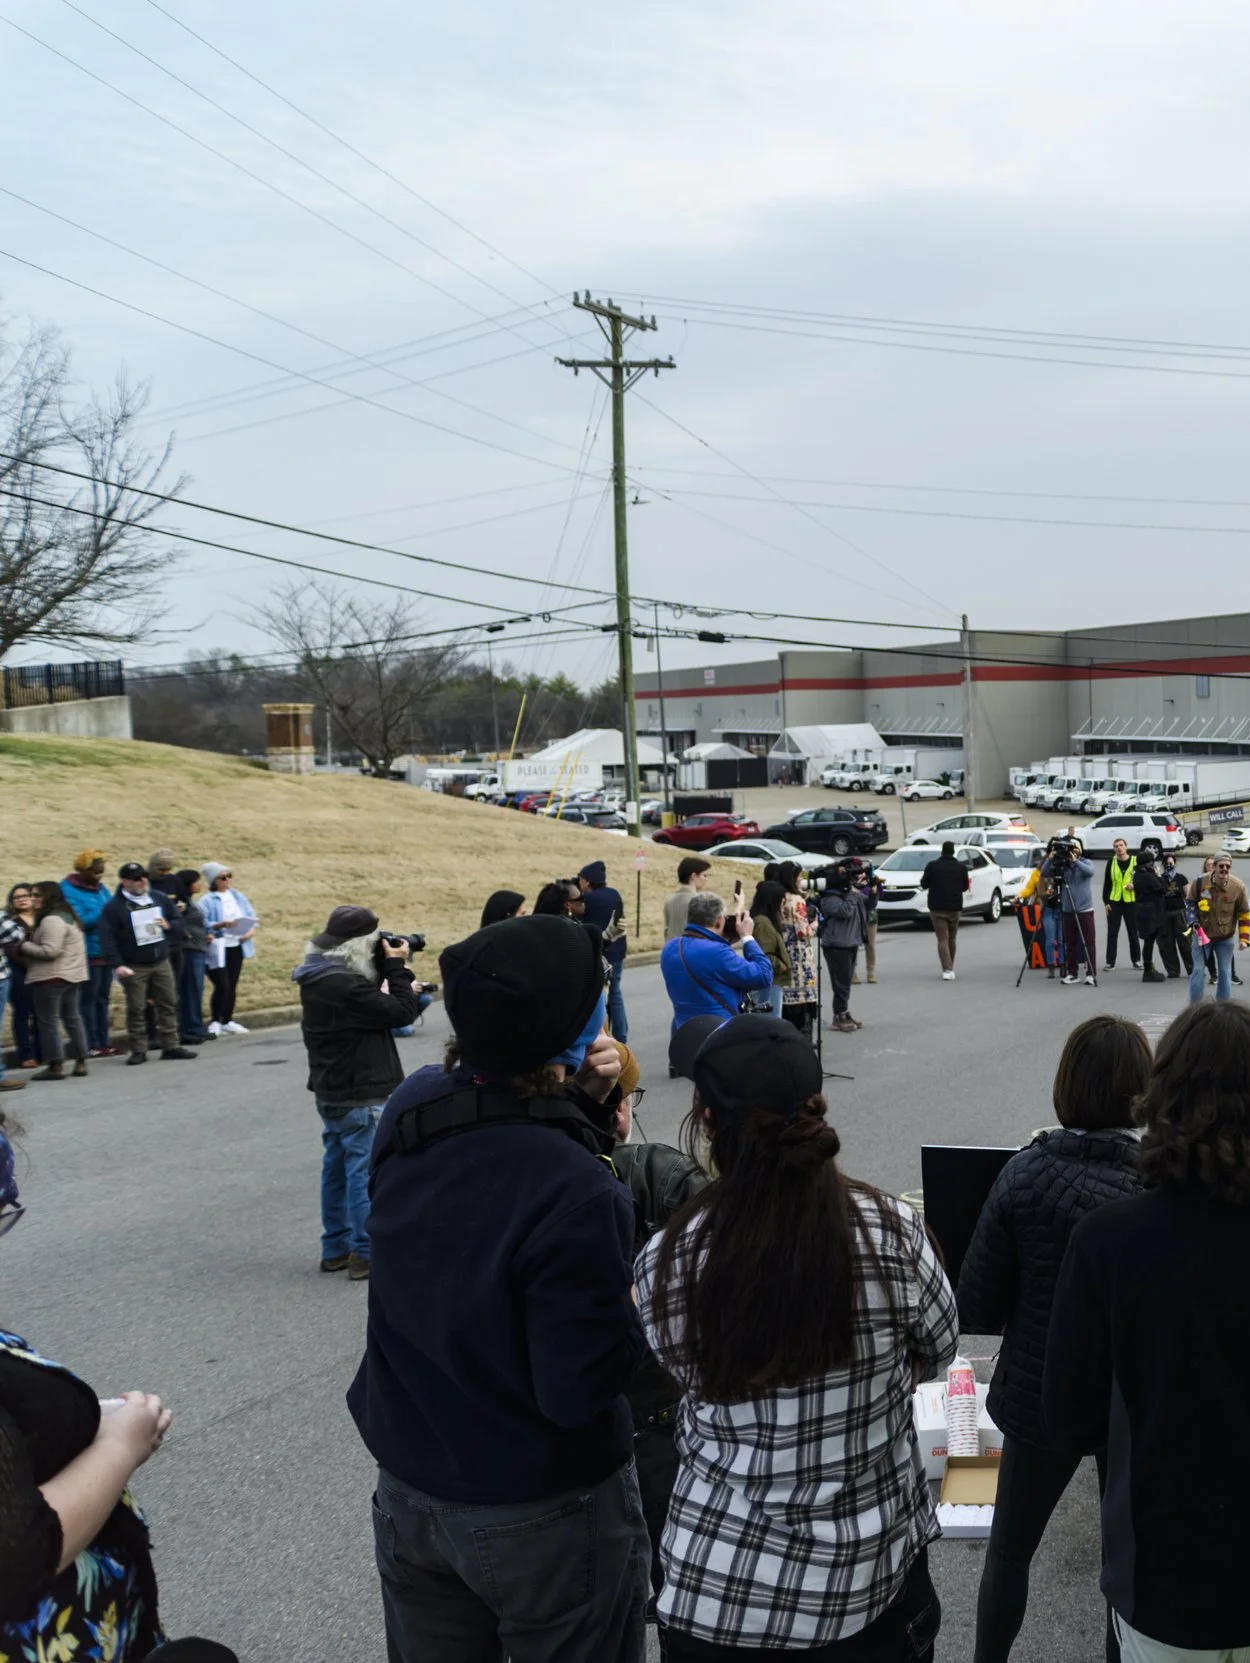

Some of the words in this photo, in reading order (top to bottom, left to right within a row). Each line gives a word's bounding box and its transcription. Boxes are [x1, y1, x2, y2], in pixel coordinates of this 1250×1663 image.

[517, 764, 547, 777] PLEASE
[1210, 813, 1226, 821] WILL
[1226, 810, 1242, 819] CALL
